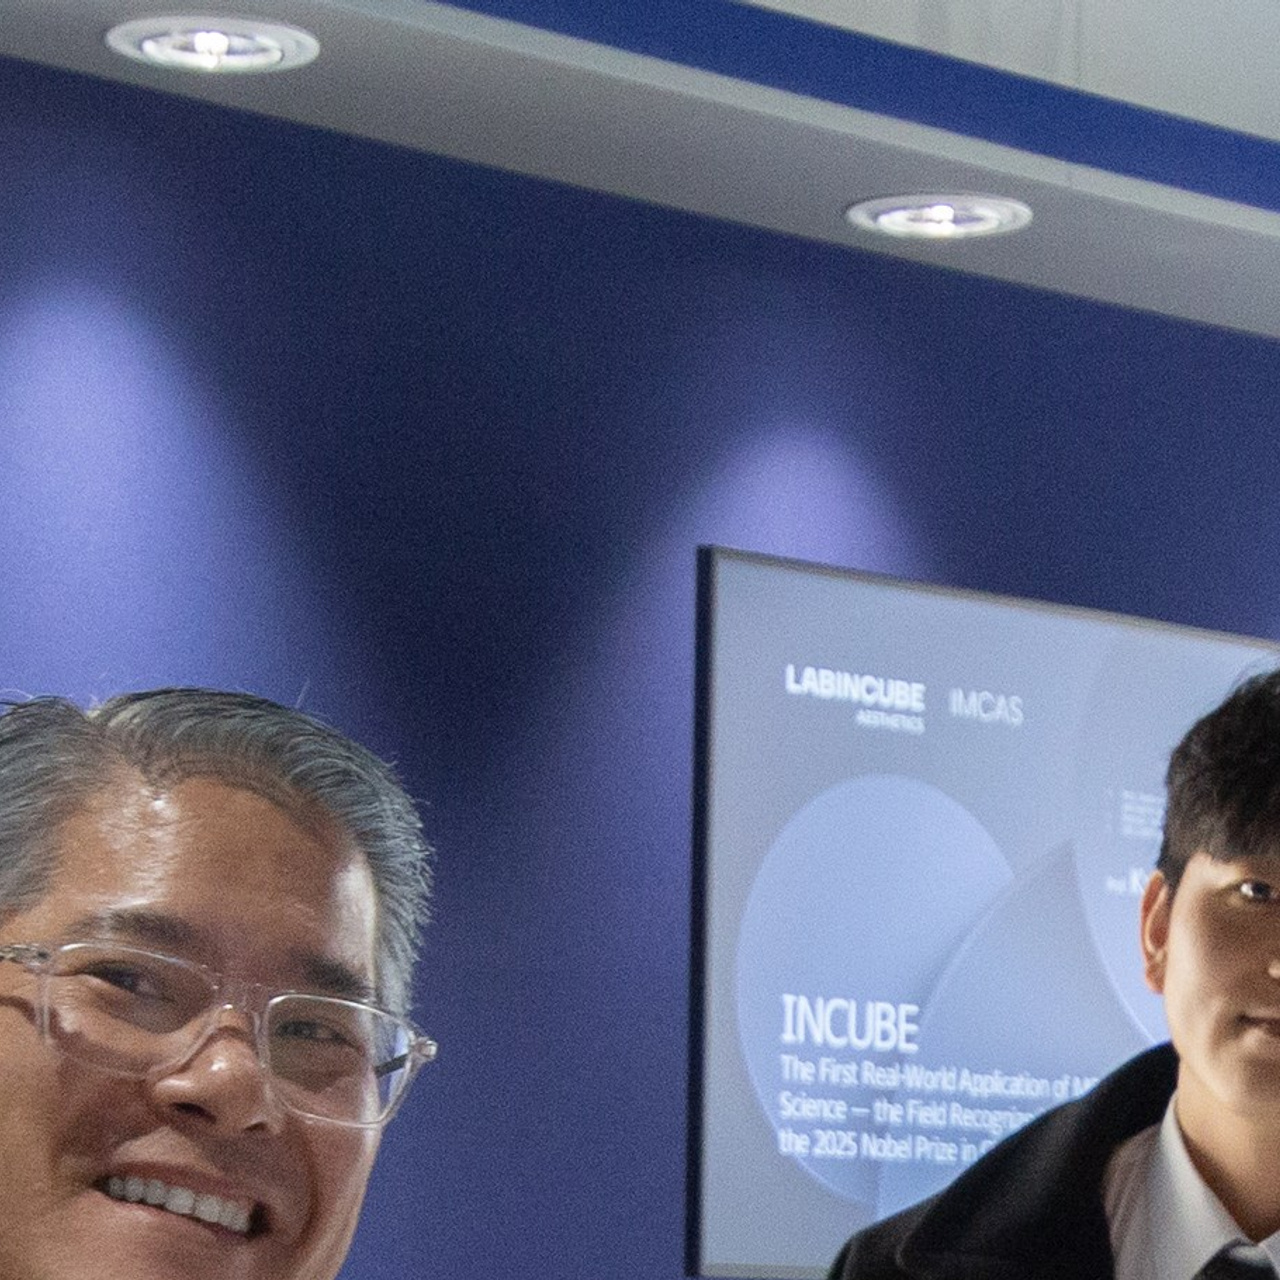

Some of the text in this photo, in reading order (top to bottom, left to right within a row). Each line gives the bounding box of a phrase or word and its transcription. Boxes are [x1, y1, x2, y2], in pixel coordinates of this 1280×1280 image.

[785, 663, 926, 712] LABINCUBE
[950, 687, 1024, 727] IMCAS
[781, 993, 920, 1055] INCUBE
[780, 1053, 816, 1084] The
[818, 1056, 859, 1088] First
[860, 1059, 957, 1093] Real-World
[958, 1066, 1049, 1099] Application
[1052, 1073, 1072, 1099] of
[778, 1090, 847, 1121] Science
[873, 1095, 904, 1125] the
[906, 1099, 948, 1128] Field
[778, 1127, 977, 1163] the 2025 Nobel Prize in
